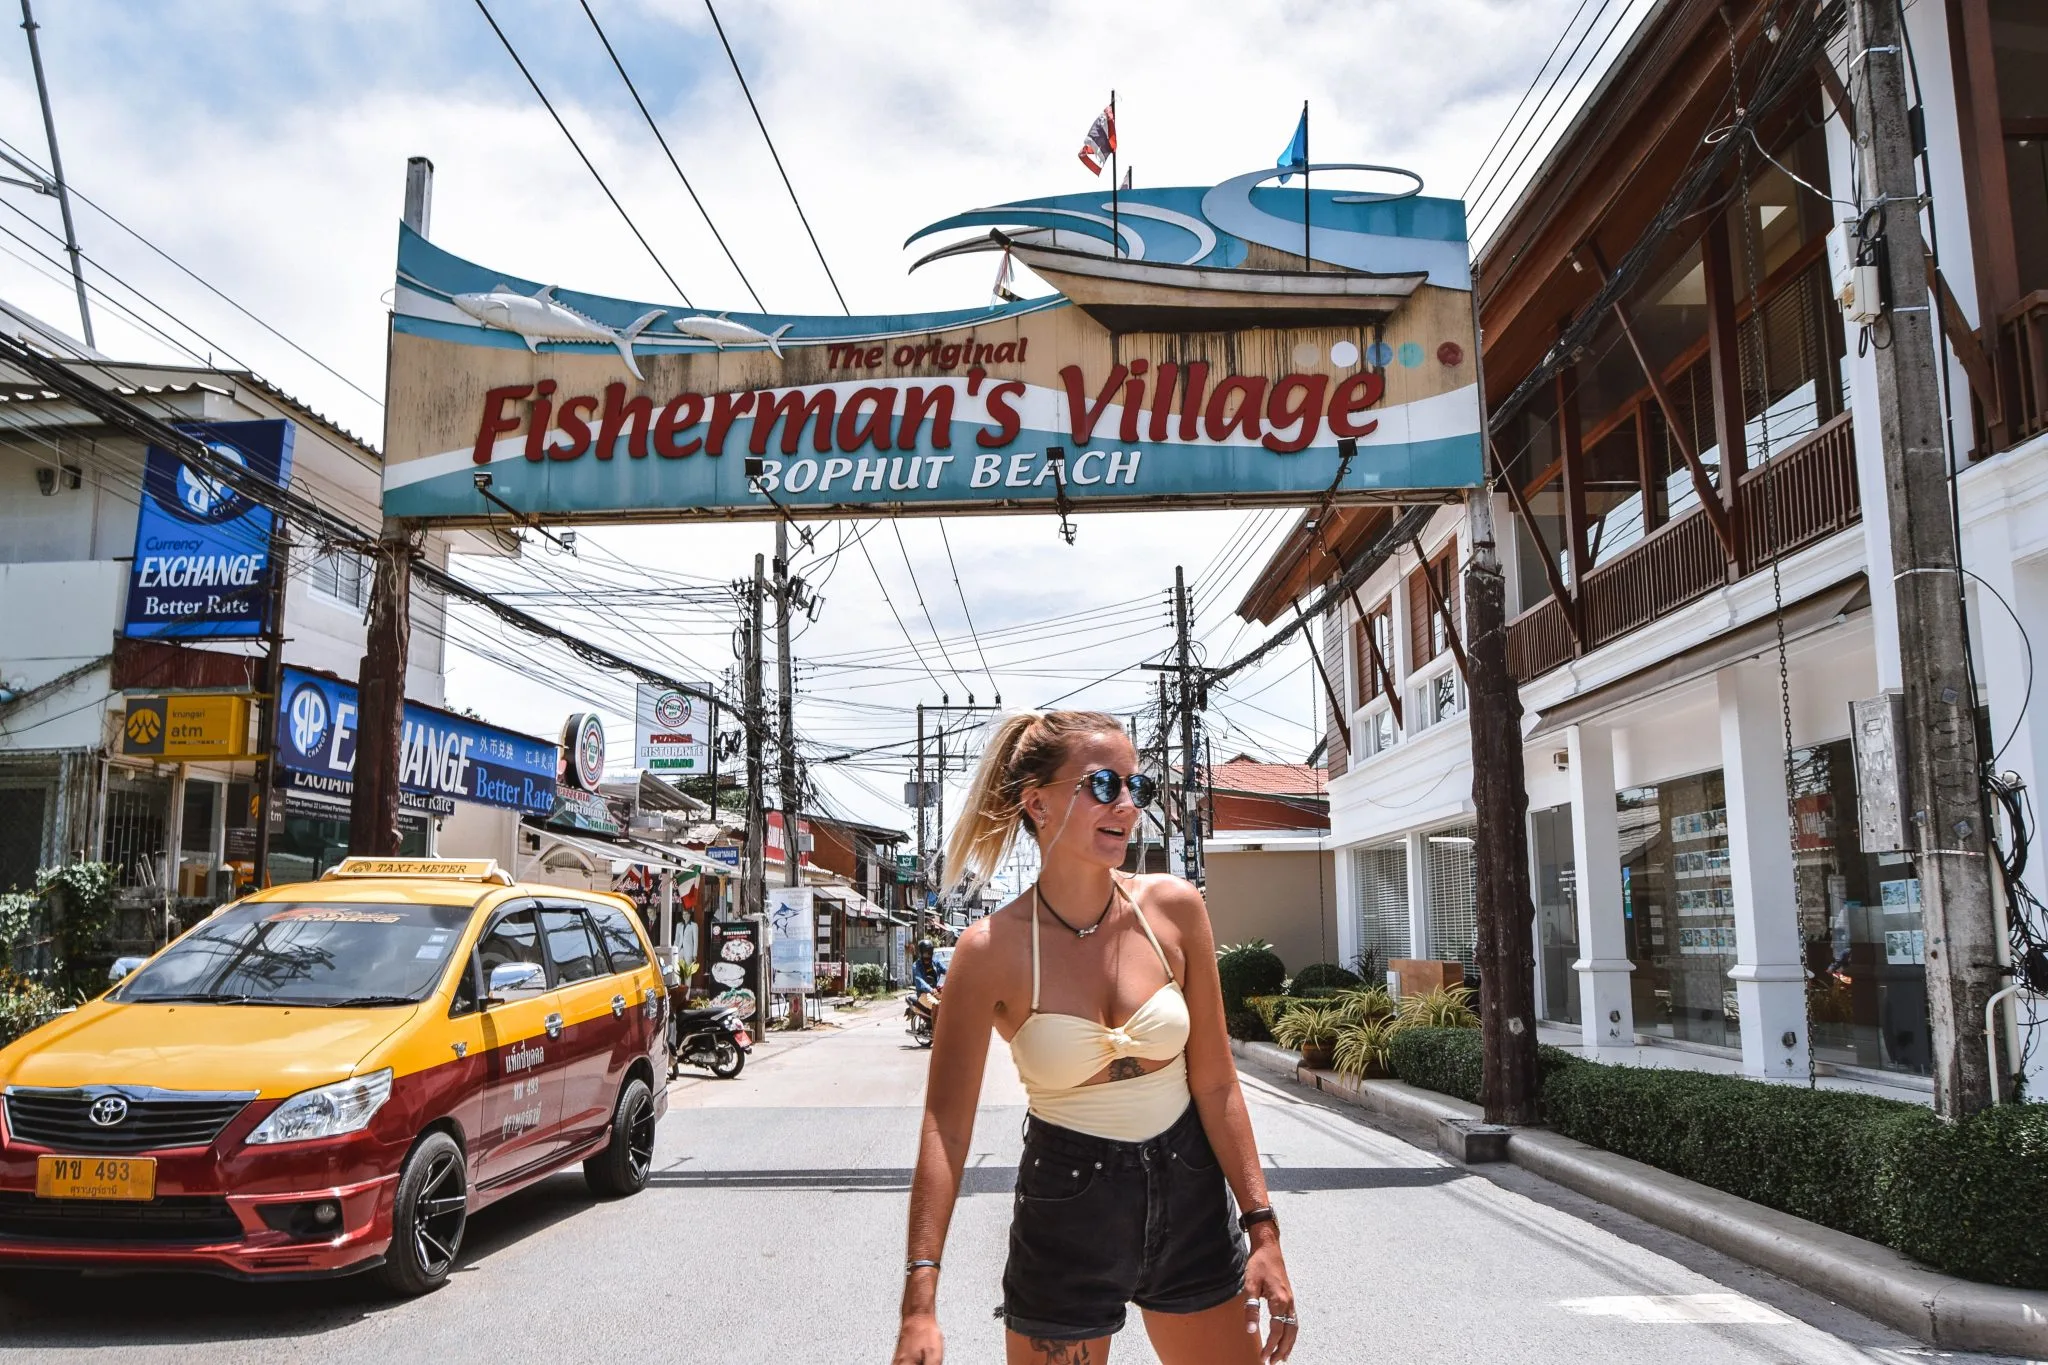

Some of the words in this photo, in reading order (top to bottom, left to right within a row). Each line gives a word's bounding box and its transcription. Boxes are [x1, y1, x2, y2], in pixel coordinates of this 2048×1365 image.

[827, 343, 882, 369] The
[893, 337, 1028, 368] original
[472, 367, 1027, 464] Fisherman's
[1059, 358, 1385, 454] Village
[748, 455, 955, 493] BOPHUT
[969, 451, 1142, 488] BEACH
[145, 536, 204, 552] Currency
[139, 554, 264, 588] EXCHANGE
[144, 596, 202, 615] Better
[206, 595, 249, 614] Rate
[171, 724, 203, 737] atm
[641, 746, 704, 757] RISTORANTE
[475, 766, 520, 805] Better
[523, 778, 554, 810] Rate
[565, 801, 612, 820] RISTORANTE
[377, 864, 467, 874] TAXI-METER
[527, 1076, 539, 1096] 493
[95, 1161, 130, 1181] 493
